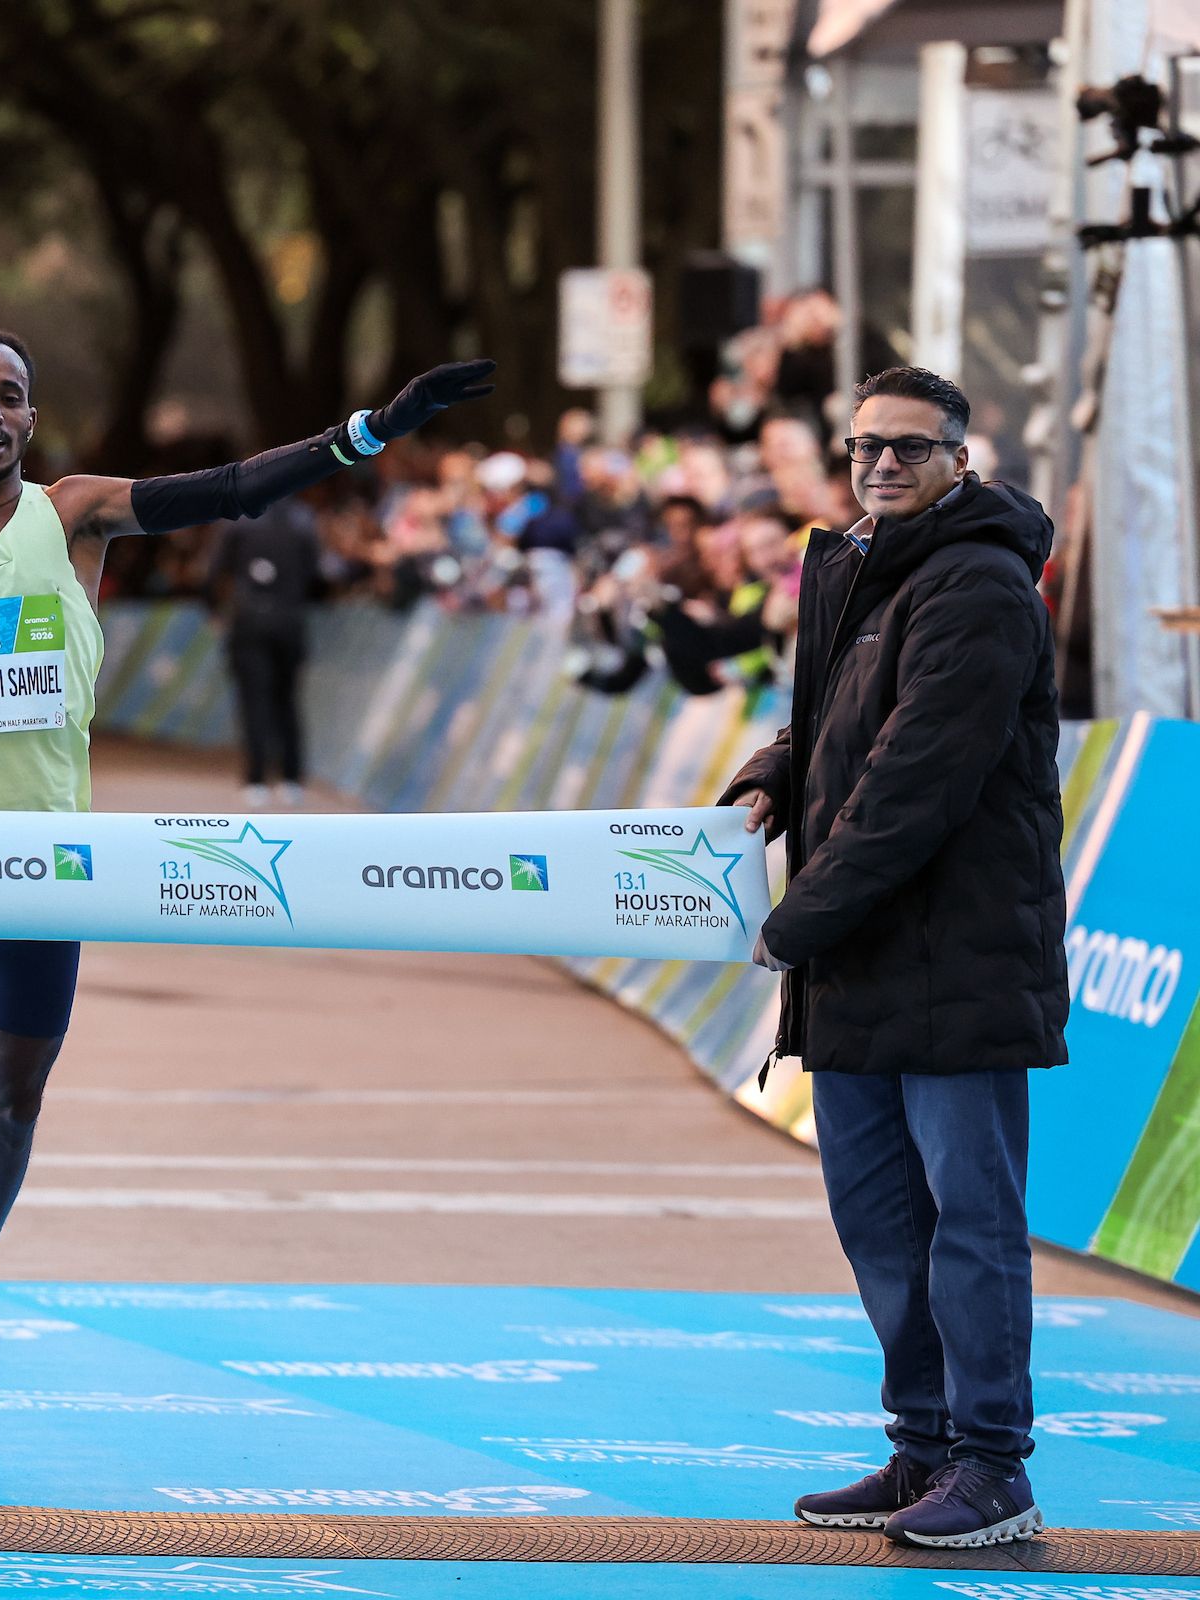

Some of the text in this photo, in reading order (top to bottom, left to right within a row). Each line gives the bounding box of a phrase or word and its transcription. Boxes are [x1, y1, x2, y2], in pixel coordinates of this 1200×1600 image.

[30, 631, 54, 640] 2026
[8, 664, 62, 697] SAMUEL
[8, 719, 21, 727] HALF
[22, 717, 48, 726] MARATHON
[154, 818, 230, 828] aramco
[609, 824, 684, 836] aramco
[160, 862, 191, 880] 13.1
[362, 864, 504, 891] aramco
[614, 872, 646, 890] 13.1
[160, 884, 257, 902] HOUSTON
[160, 903, 274, 918] HALF MARATHON
[615, 893, 711, 912] HOUSTON
[616, 913, 729, 928] HALF MARATHON
[1068, 923, 1183, 1028] ramco
[932, 1582, 1200, 1595] CHEVRO
